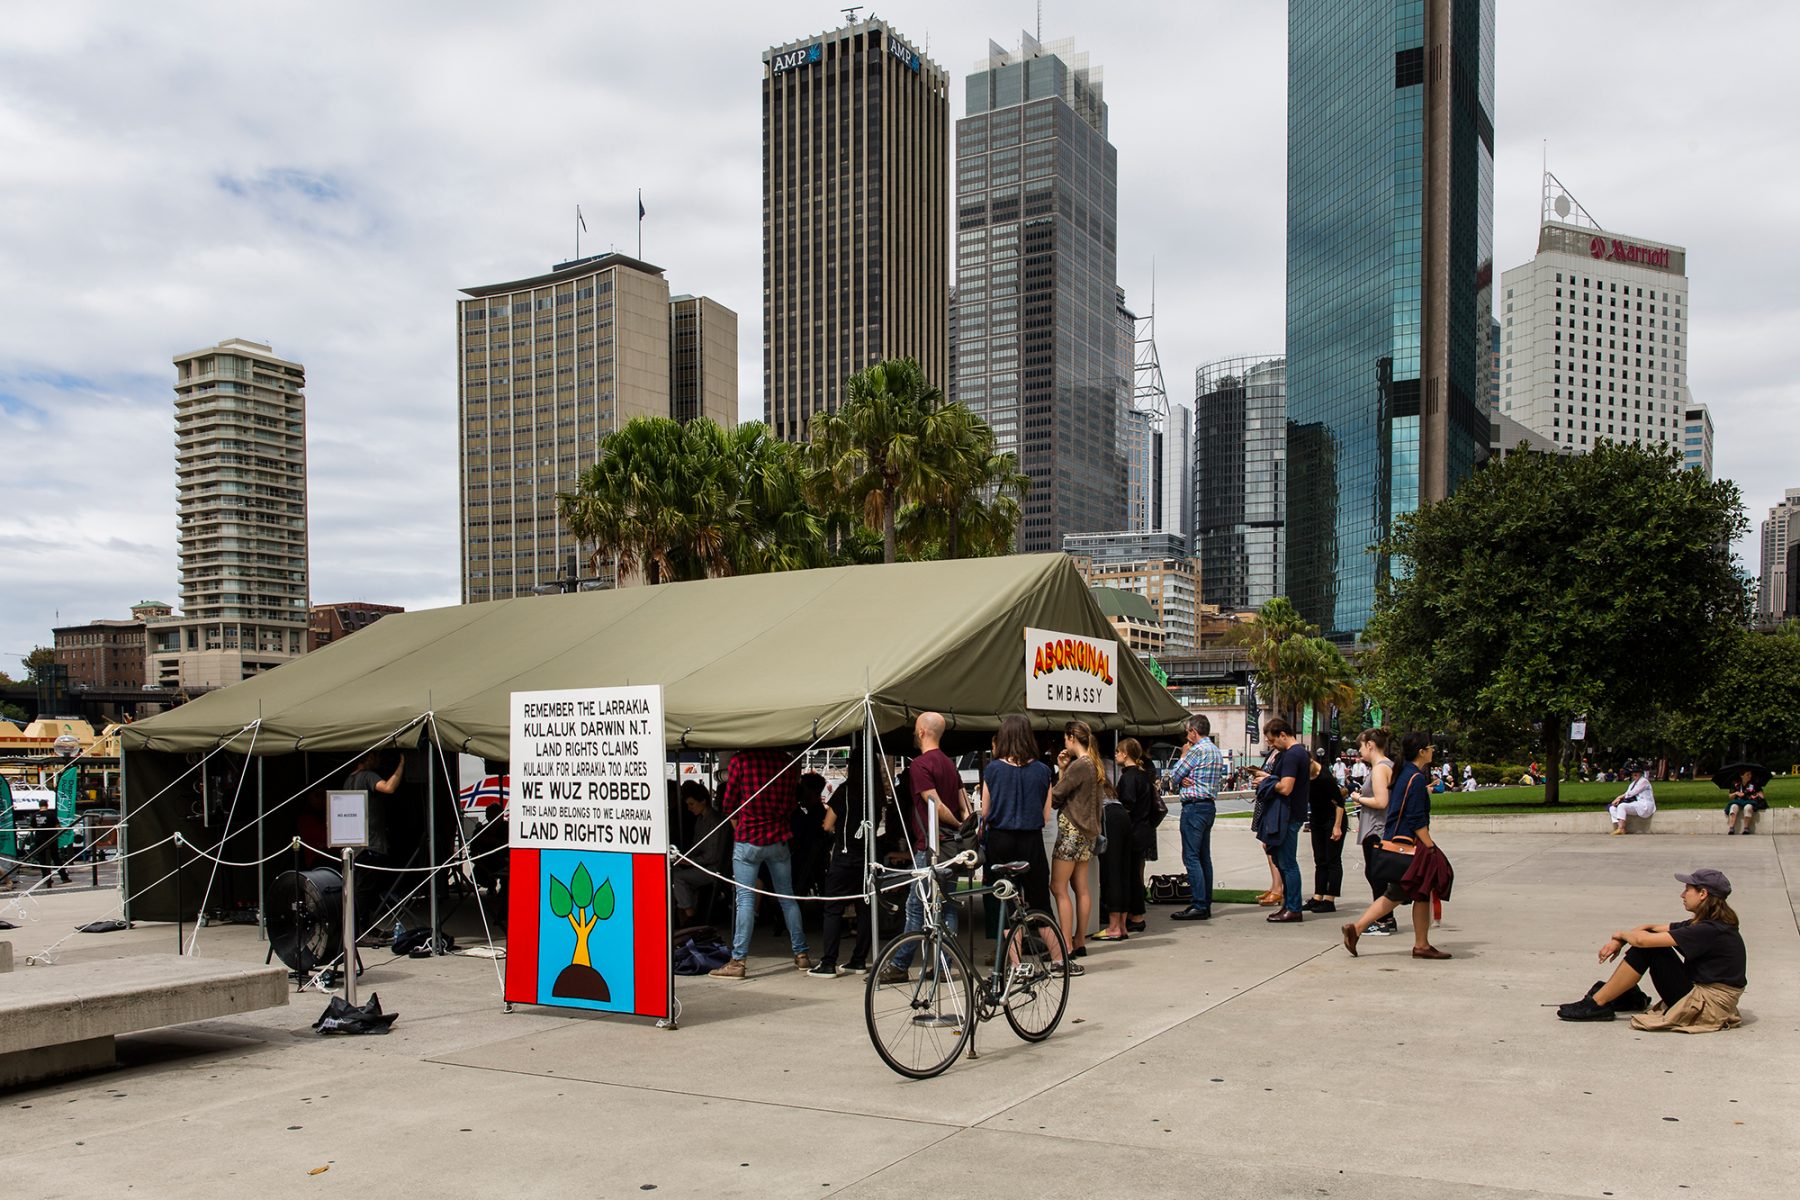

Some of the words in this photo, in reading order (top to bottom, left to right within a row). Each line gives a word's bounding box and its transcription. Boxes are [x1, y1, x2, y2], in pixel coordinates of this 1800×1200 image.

[774, 50, 806, 72] AMP
[890, 39, 911, 64] AMP
[1605, 239, 1669, 268] Marriott
[1033, 639, 1113, 686] ABORIGINAL
[1048, 684, 1102, 703] EMBASSY
[524, 702, 574, 718] REMEMBER
[578, 702, 595, 716] THE
[599, 699, 649, 716] LARRAKIA
[524, 722, 576, 737] KULALUK
[581, 721, 625, 736] DARWIN
[630, 720, 651, 735] N.T.
[536, 743, 562, 756] LAND
[565, 742, 598, 756] RIGHTS
[602, 741, 638, 755] CLAIMS
[524, 762, 555, 776] KULALUK
[556, 762, 569, 776] FOR
[572, 762, 606, 776] LARRAKIA
[608, 762, 621, 776] 700
[624, 762, 647, 776] ACRES
[522, 782, 543, 799] WE
[549, 782, 582, 800] WUZ
[588, 782, 651, 800] ROBBED
[522, 805, 536, 816] THIS
[539, 806, 557, 818] LAND
[560, 807, 590, 818] BELONGS
[593, 808, 600, 819] TO
[603, 808, 614, 819] WE
[616, 808, 652, 821] LARRAKIA
[520, 822, 558, 840] LAND
[564, 824, 613, 843] RIGHTS
[619, 826, 651, 845] NOW
